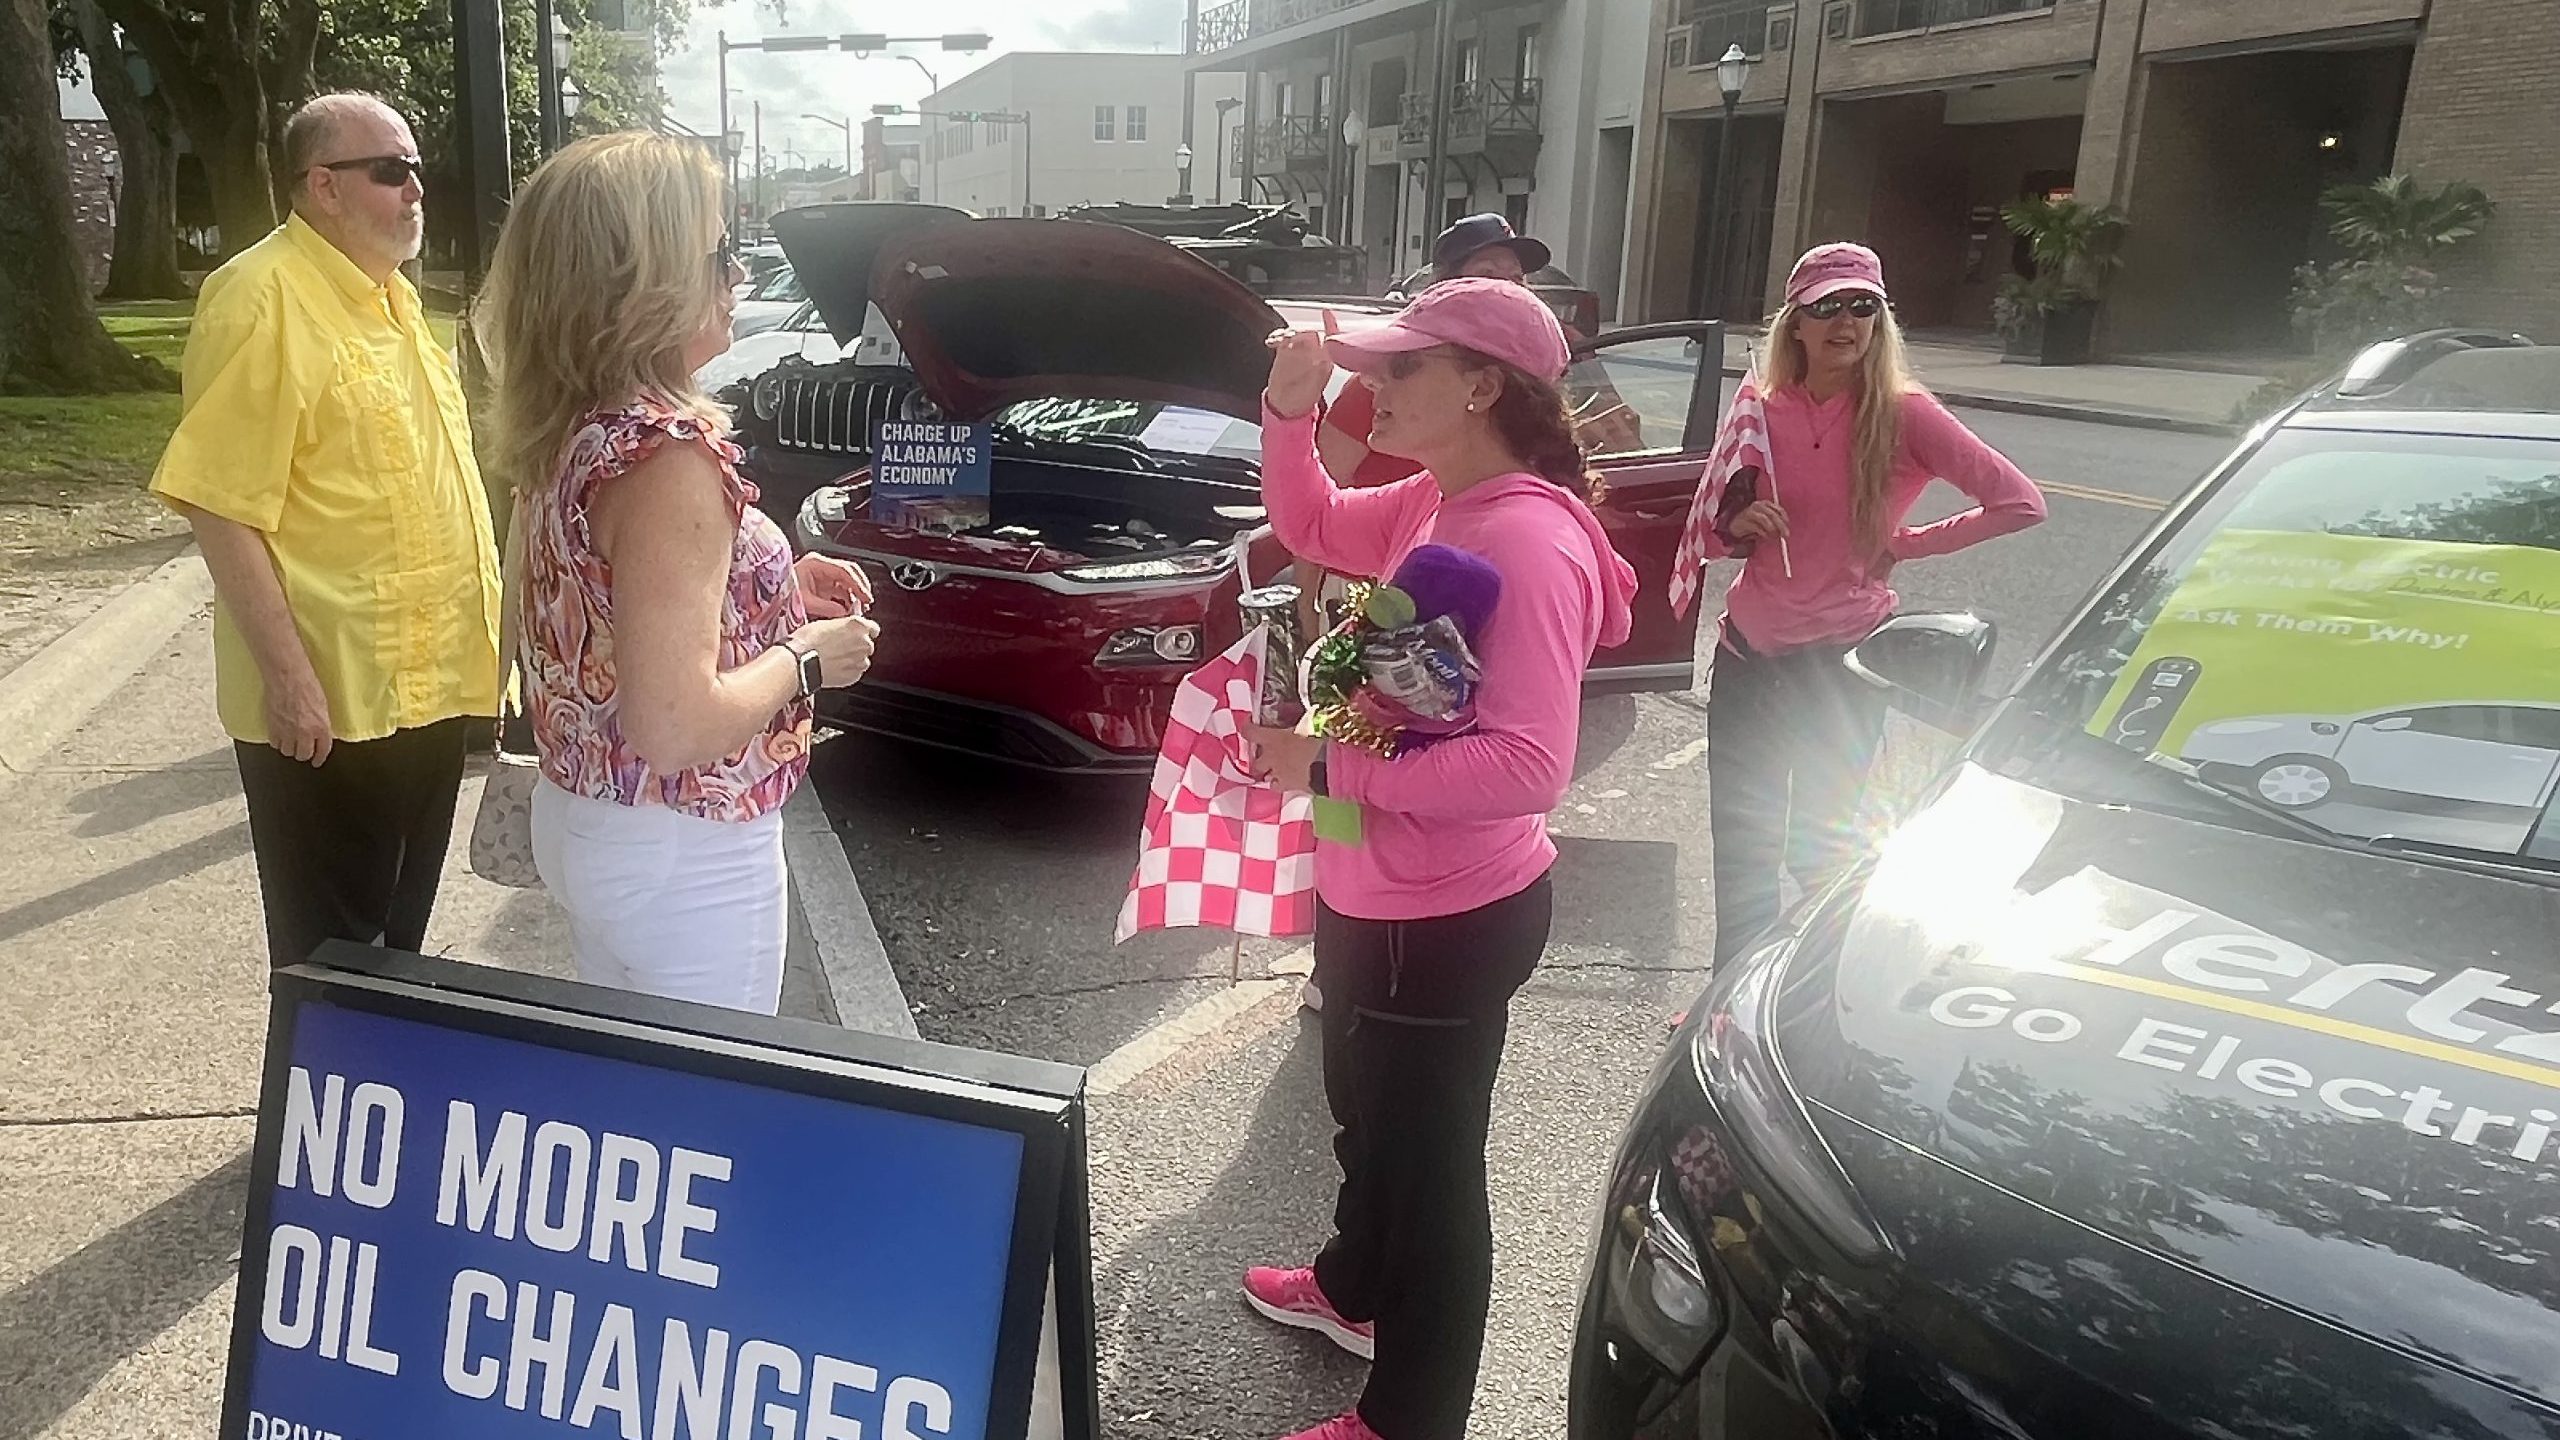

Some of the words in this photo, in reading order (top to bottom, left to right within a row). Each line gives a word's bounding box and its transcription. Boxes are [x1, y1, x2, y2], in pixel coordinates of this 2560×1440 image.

[881, 423, 945, 443] CHARGE
[950, 425, 971, 443] UP
[881, 444, 976, 464] ALABAMA'S
[880, 466, 957, 485] ECONOMY
[2177, 609, 2241, 626] Ask
[2256, 612, 2352, 636] Them
[2367, 622, 2469, 650] Why!
[1930, 986, 2082, 1043] Go
[2116, 1018, 2560, 1163] Electri
[277, 1065, 404, 1209] NO
[435, 1099, 733, 1288] MORE
[261, 1224, 400, 1376] OIL
